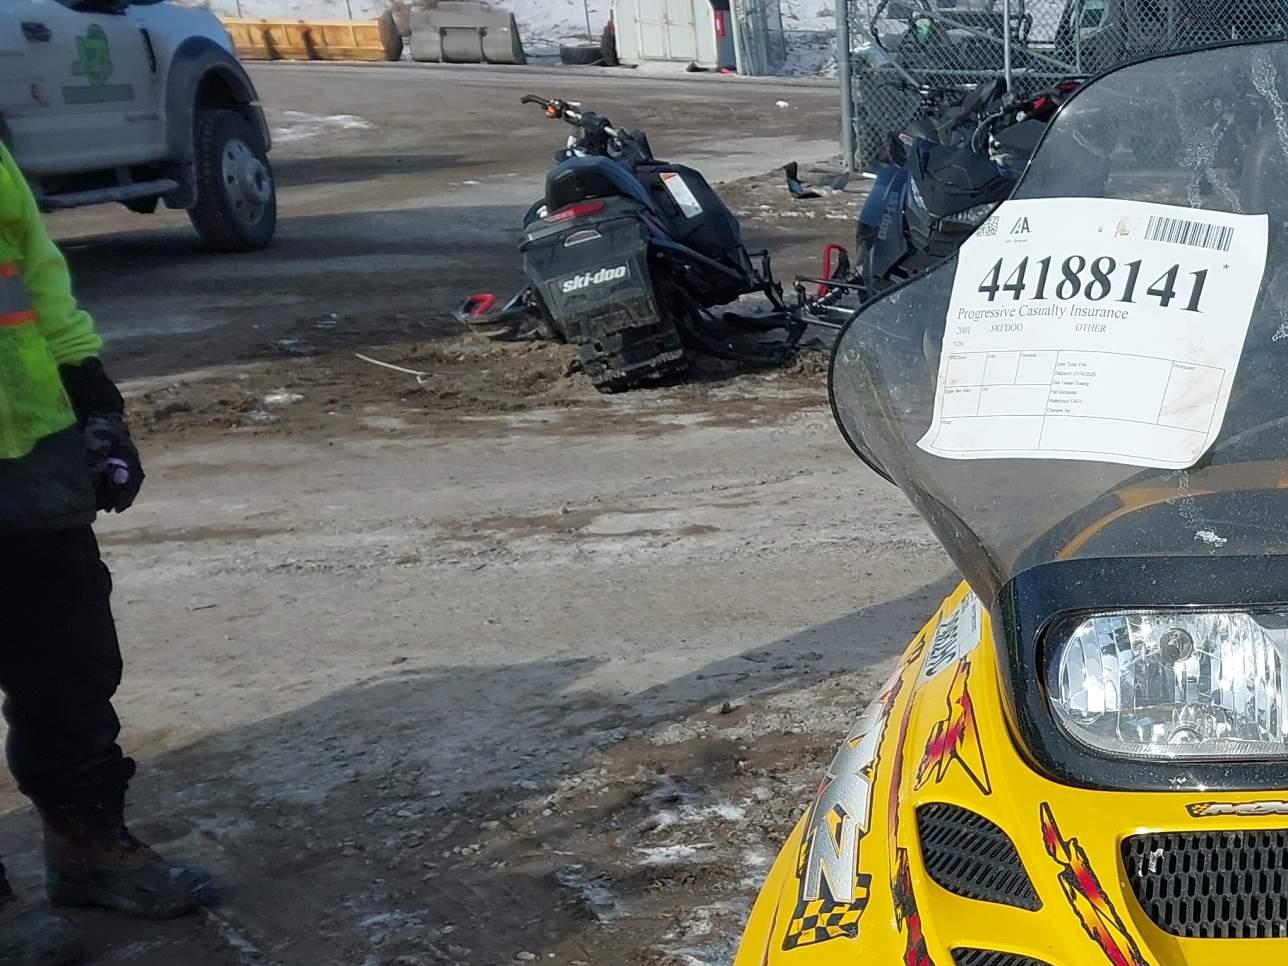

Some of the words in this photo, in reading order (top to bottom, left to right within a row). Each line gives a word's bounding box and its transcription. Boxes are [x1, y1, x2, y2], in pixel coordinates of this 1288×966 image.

[562, 265, 627, 293] ski-doo
[977, 255, 1209, 314] 44188141
[957, 306, 1016, 322] Progressive
[1018, 303, 1066, 320] Casualty
[1069, 303, 1129, 320] Insurance
[1075, 322, 1107, 333] OTHER
